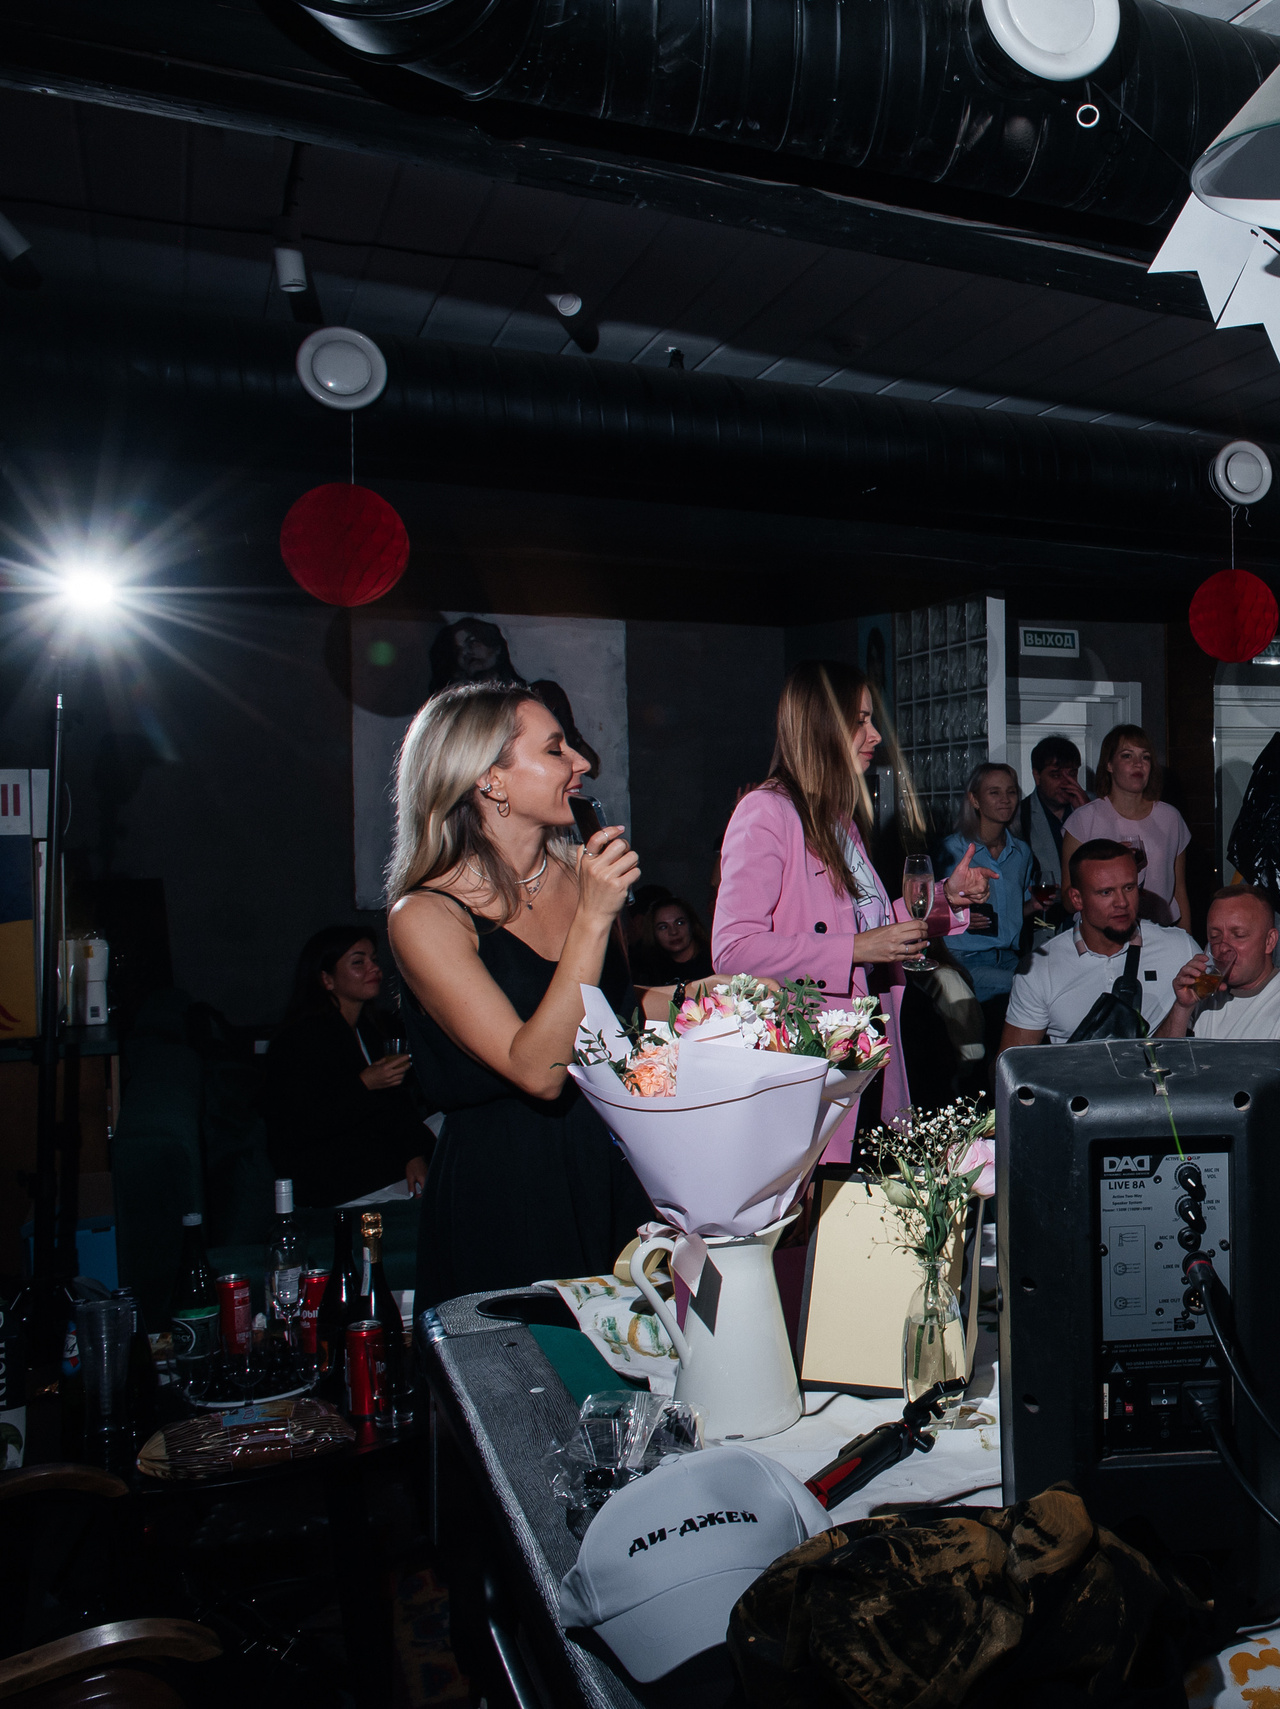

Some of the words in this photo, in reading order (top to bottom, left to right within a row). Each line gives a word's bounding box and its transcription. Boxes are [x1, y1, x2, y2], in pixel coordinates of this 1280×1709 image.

[1025, 633, 1073, 649] ВЫХОД
[1109, 1181, 1130, 1190] LIVE
[1132, 1180, 1146, 1189] 8A
[628, 1510, 758, 1558] ДИ-ДЖЕЙ
